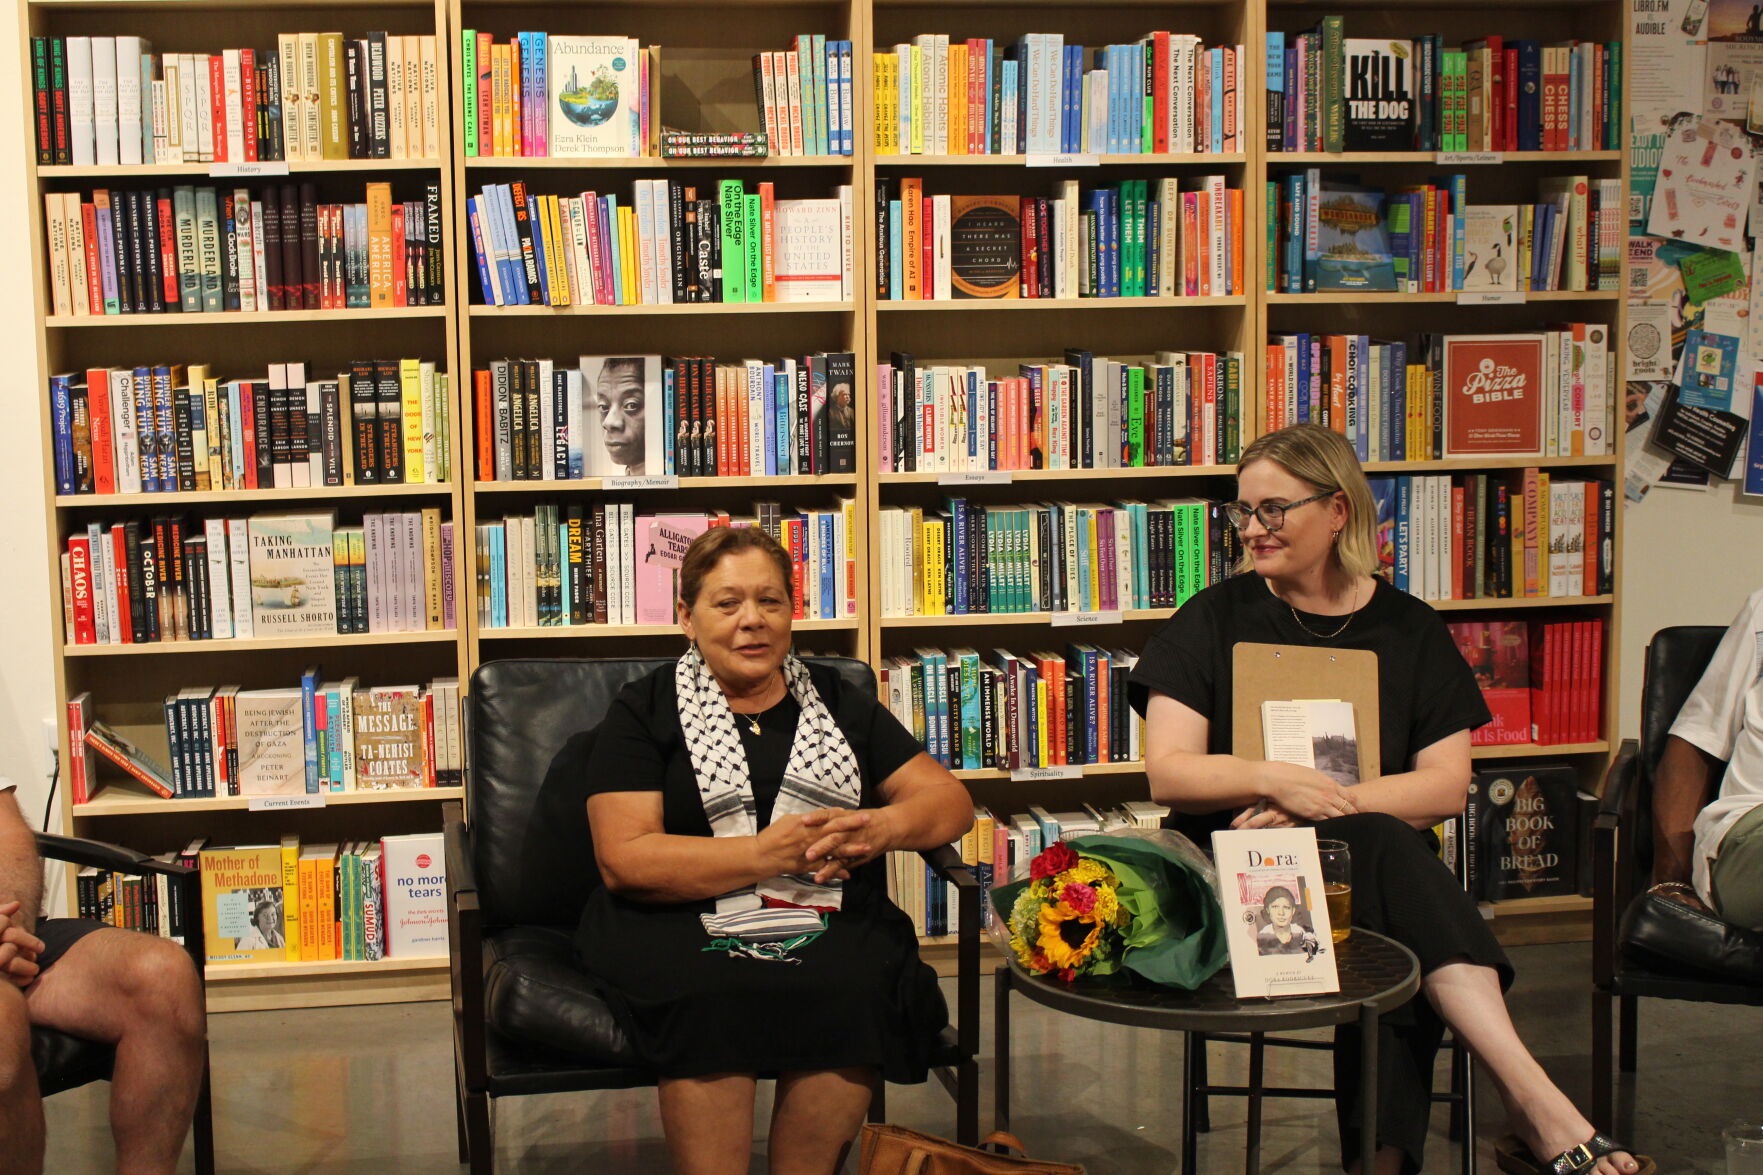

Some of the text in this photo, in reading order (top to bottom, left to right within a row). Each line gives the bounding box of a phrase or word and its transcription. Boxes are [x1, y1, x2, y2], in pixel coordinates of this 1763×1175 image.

[1636, 23, 1666, 35] AUDIBLE
[554, 42, 624, 55] Abundance
[521, 38, 530, 98] GENESIS
[535, 39, 544, 98] GENESIS
[371, 43, 386, 140] DEADWOOD PETER COZZENS
[938, 55, 947, 131] Atomic Habits
[1172, 86, 1180, 138] Conversation
[1349, 101, 1409, 119] THE DOG
[1545, 85, 1556, 130] CHESS
[1558, 85, 1568, 130] CHESS
[555, 135, 574, 143] Ezra
[555, 145, 626, 154] Derek Thompson
[709, 135, 738, 143] BEHAVIOR
[238, 166, 262, 174] History
[1053, 156, 1072, 164] Health
[725, 186, 733, 208] Nate
[735, 186, 741, 198] On
[224, 195, 232, 219] When
[427, 186, 440, 243] FRAMED
[733, 220, 742, 246] Edge
[179, 219, 196, 289] MURDERLAND
[202, 220, 217, 290] MURDERLAND
[521, 238, 537, 284] PAOLA RAMOS
[699, 240, 711, 280] Caste
[909, 260, 916, 270] of
[909, 270, 916, 279] AI
[1216, 363, 1224, 400] CARBON
[1497, 366, 1517, 376] The
[497, 366, 507, 400] DIDION
[798, 371, 807, 411] NEKO CASE
[1462, 371, 1527, 395] Pizza
[120, 378, 130, 429] Challenger
[154, 376, 165, 432] KING TUT
[1348, 375, 1356, 427] COOKING
[1473, 389, 1524, 403] BIBLE
[164, 410, 172, 432] WITH
[256, 395, 268, 449] ENDURANCE
[326, 403, 334, 441] SPLENDID
[529, 394, 539, 430] ANGELICA
[500, 409, 509, 444] BABITZ
[556, 425, 566, 465] LEGACY
[159, 455, 167, 479] KEAN
[168, 456, 176, 477] SAM
[611, 477, 669, 489] Biography/Memoir
[958, 504, 964, 512] IS
[1527, 480, 1537, 546] COMPANY
[254, 535, 293, 546] TAKING
[568, 519, 582, 563] DREAM
[595, 512, 604, 562] Ina Garten
[988, 531, 996, 552] LYDIA
[172, 524, 182, 581] MEDICINE RIVER
[267, 547, 331, 559] MANHATTAN
[958, 547, 966, 575] ALIVE?
[1400, 544, 1408, 576] PARTY
[72, 547, 87, 599] CHAOS
[143, 551, 155, 599] OCTOBER
[261, 613, 334, 624] RUSSELL SHORTO
[926, 665, 935, 704] ON MUSCLE
[984, 674, 990, 684] AN
[267, 708, 294, 716] JEWISH
[378, 702, 391, 712] THE
[358, 714, 413, 732] MESSAGE
[1484, 729, 1526, 741] Is Food
[361, 744, 413, 759] TA-NEHISI
[370, 761, 408, 775] COATES
[264, 800, 290, 808] Current
[1515, 797, 1544, 812] BIG
[1506, 816, 1555, 832] BOOK
[1518, 835, 1541, 850] OF
[204, 856, 260, 872] Mother of
[1500, 853, 1558, 870] BREAD
[214, 872, 277, 888] Methadone
[398, 877, 414, 886] no
[408, 888, 442, 898] tears
[365, 904, 374, 941] SUMUD
